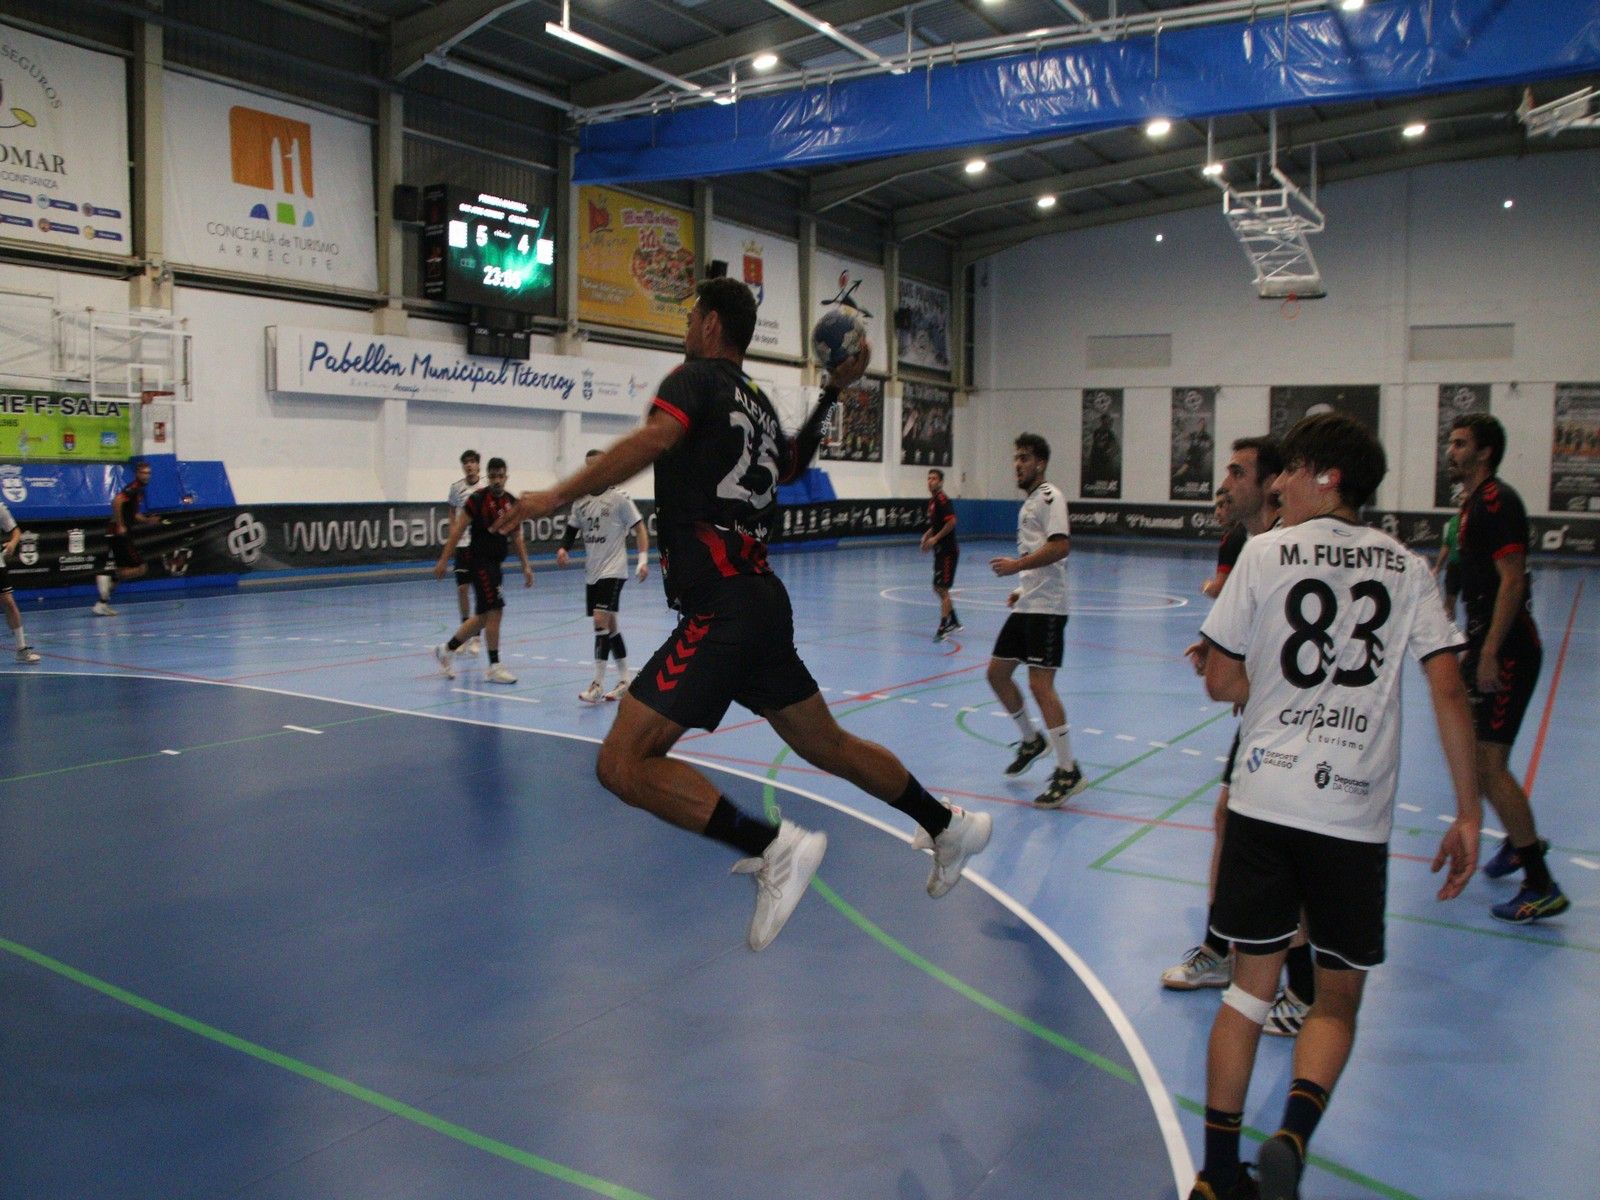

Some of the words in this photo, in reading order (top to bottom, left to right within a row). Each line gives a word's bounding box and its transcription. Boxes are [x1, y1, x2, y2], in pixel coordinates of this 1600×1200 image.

[1, 44, 62, 109] SEGUROS
[279, 233, 291, 248] de
[293, 236, 340, 256] TURISMO
[476, 224, 488, 247] 5
[517, 234, 530, 256] 4
[308, 340, 406, 376] Pabellón
[410, 353, 509, 393] Municipal
[511, 362, 575, 401] Titerroy
[33, 396, 53, 414] F.
[61, 397, 121, 417] SALA
[734, 386, 778, 441] ALEXIS
[716, 410, 780, 510] 25
[1279, 544, 1308, 567] M.
[1314, 544, 1406, 573] FUENTES
[1280, 578, 1391, 689] 83
[1318, 734, 1364, 751] turismo
[1262, 757, 1293, 770] GALEGO
[1265, 750, 1299, 763] DEPORTE
